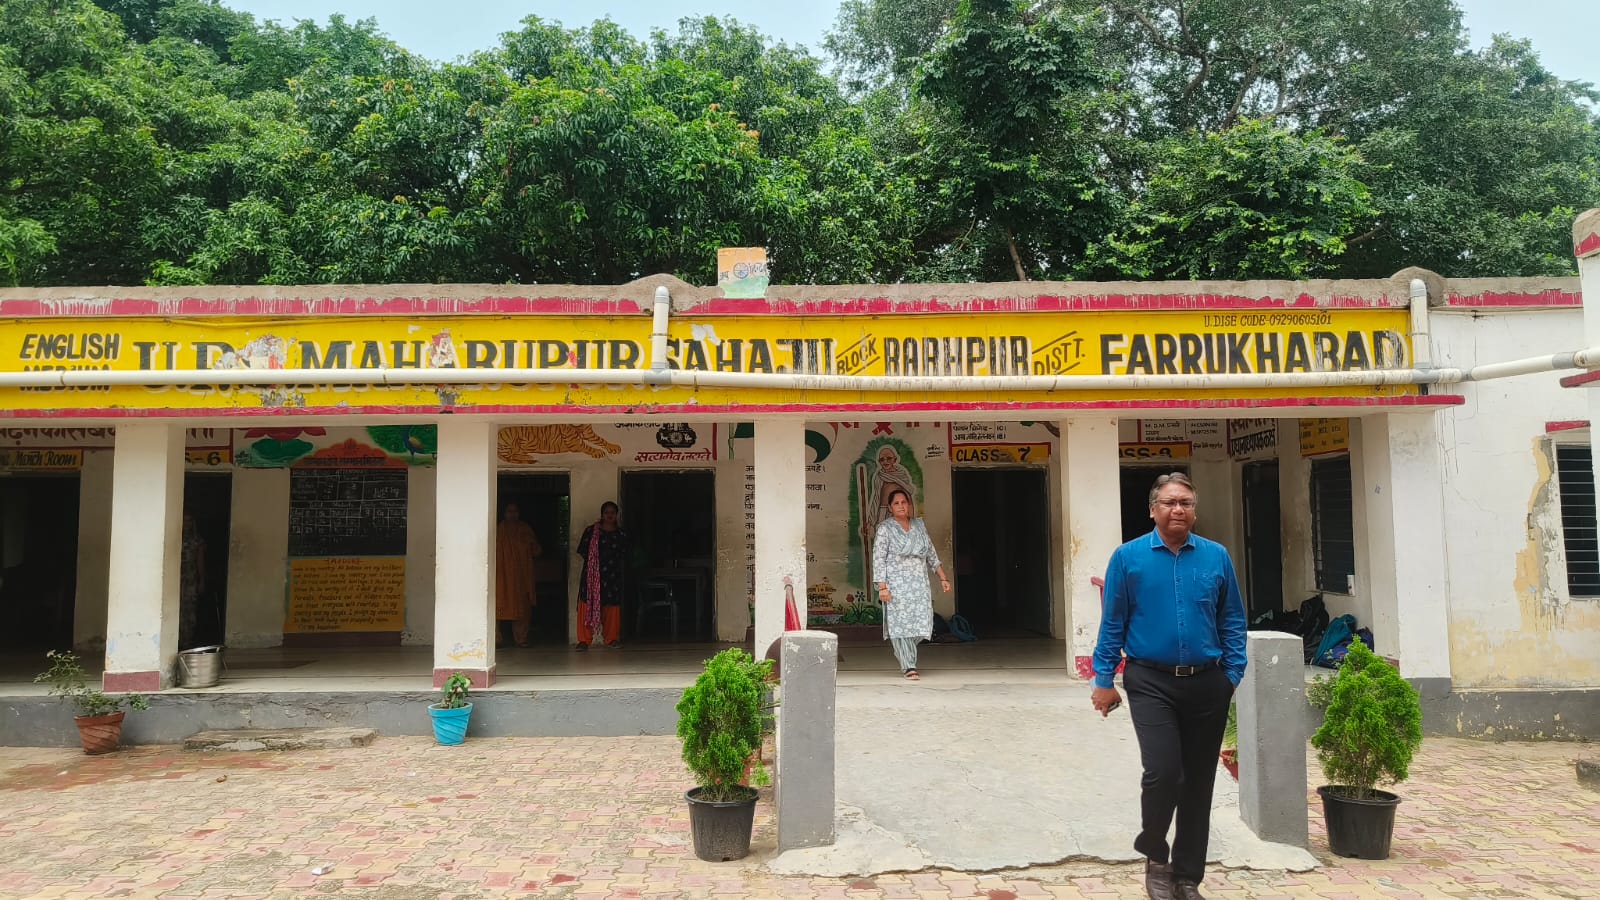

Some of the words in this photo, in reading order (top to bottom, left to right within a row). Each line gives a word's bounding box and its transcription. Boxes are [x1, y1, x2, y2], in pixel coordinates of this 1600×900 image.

[19, 333, 120, 360] ENGLISH
[837, 338, 877, 374] BLOCK
[1100, 331, 1404, 374] FARRUKHABAD
[1018, 447, 1031, 462] 7
